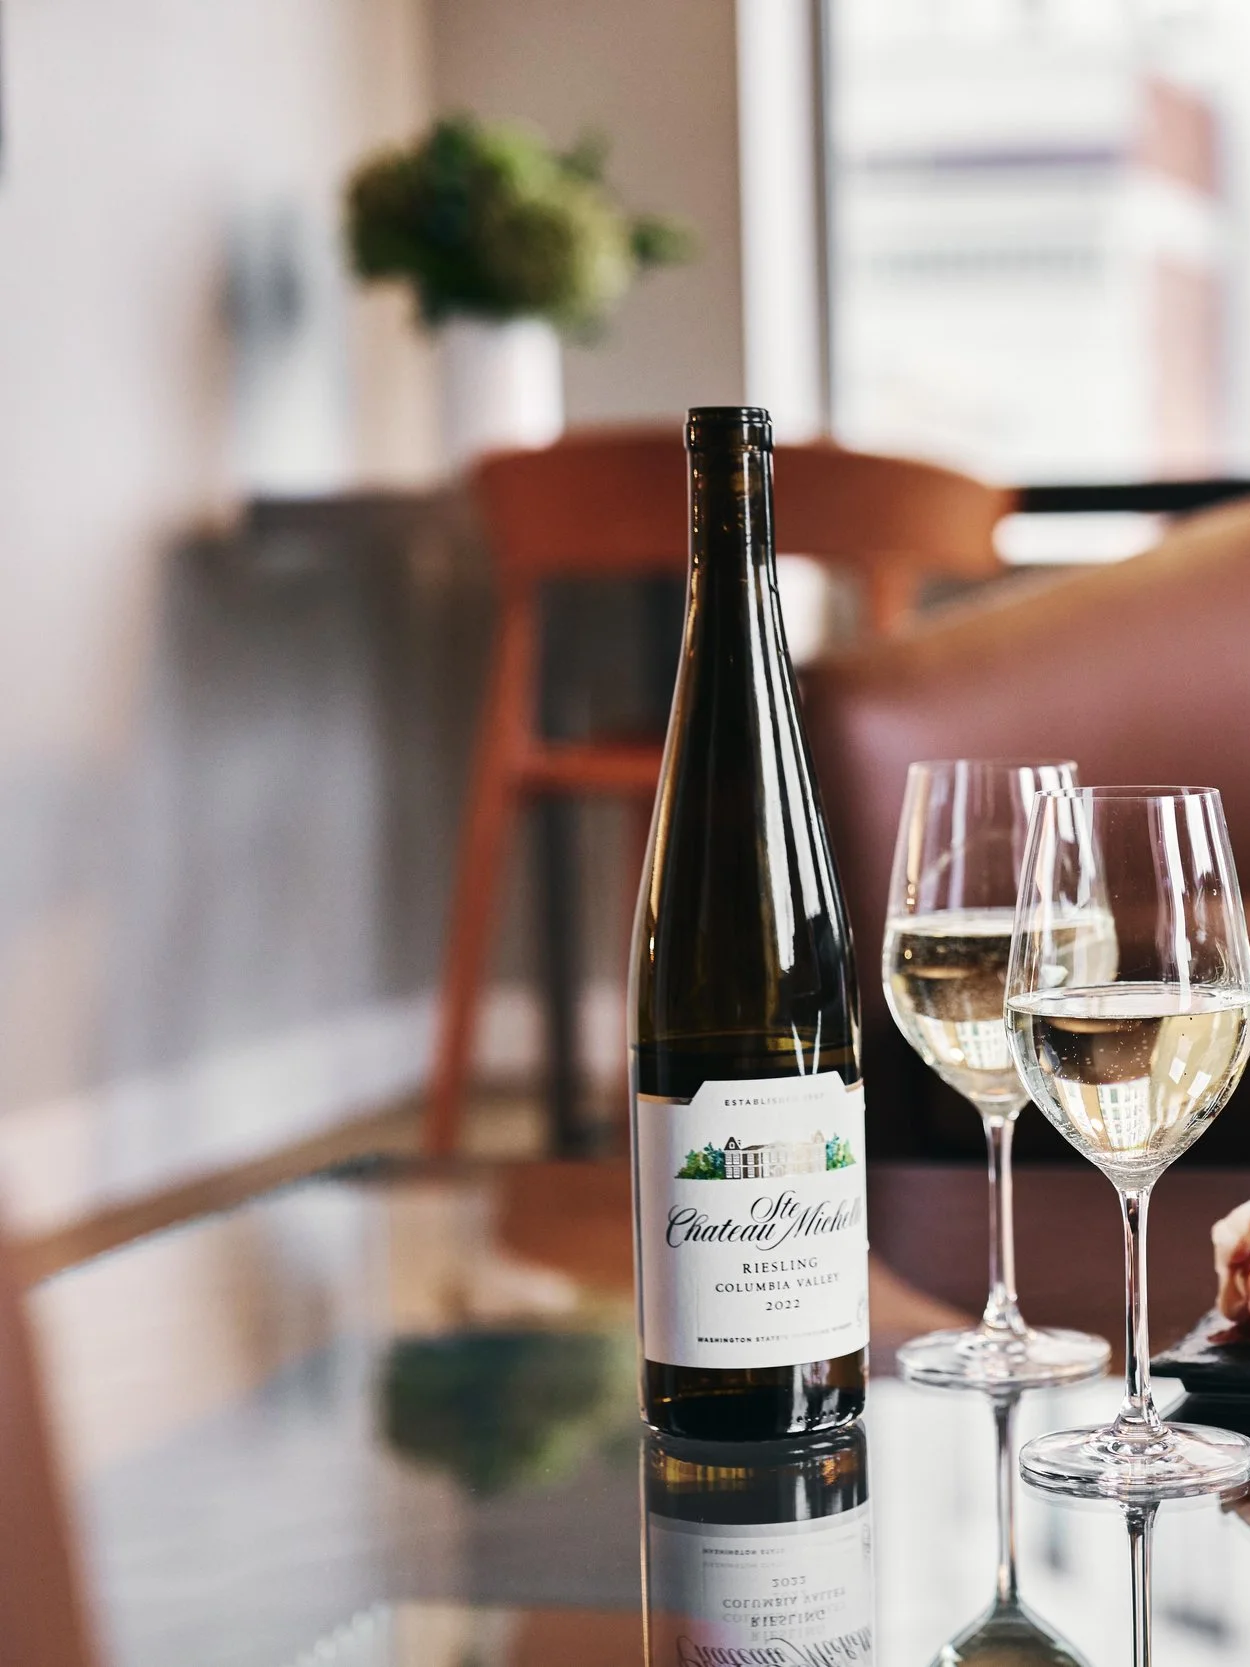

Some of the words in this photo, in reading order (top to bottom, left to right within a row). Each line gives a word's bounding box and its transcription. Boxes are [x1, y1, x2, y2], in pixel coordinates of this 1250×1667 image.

[750, 1189, 801, 1223] Ste
[666, 1204, 777, 1248] Chateau
[756, 1194, 863, 1251] Michell
[743, 1257, 818, 1274] RIESLING
[715, 1280, 790, 1293] COLUMBIA
[797, 1273, 840, 1288] VALLEY
[766, 1299, 801, 1311] 2022
